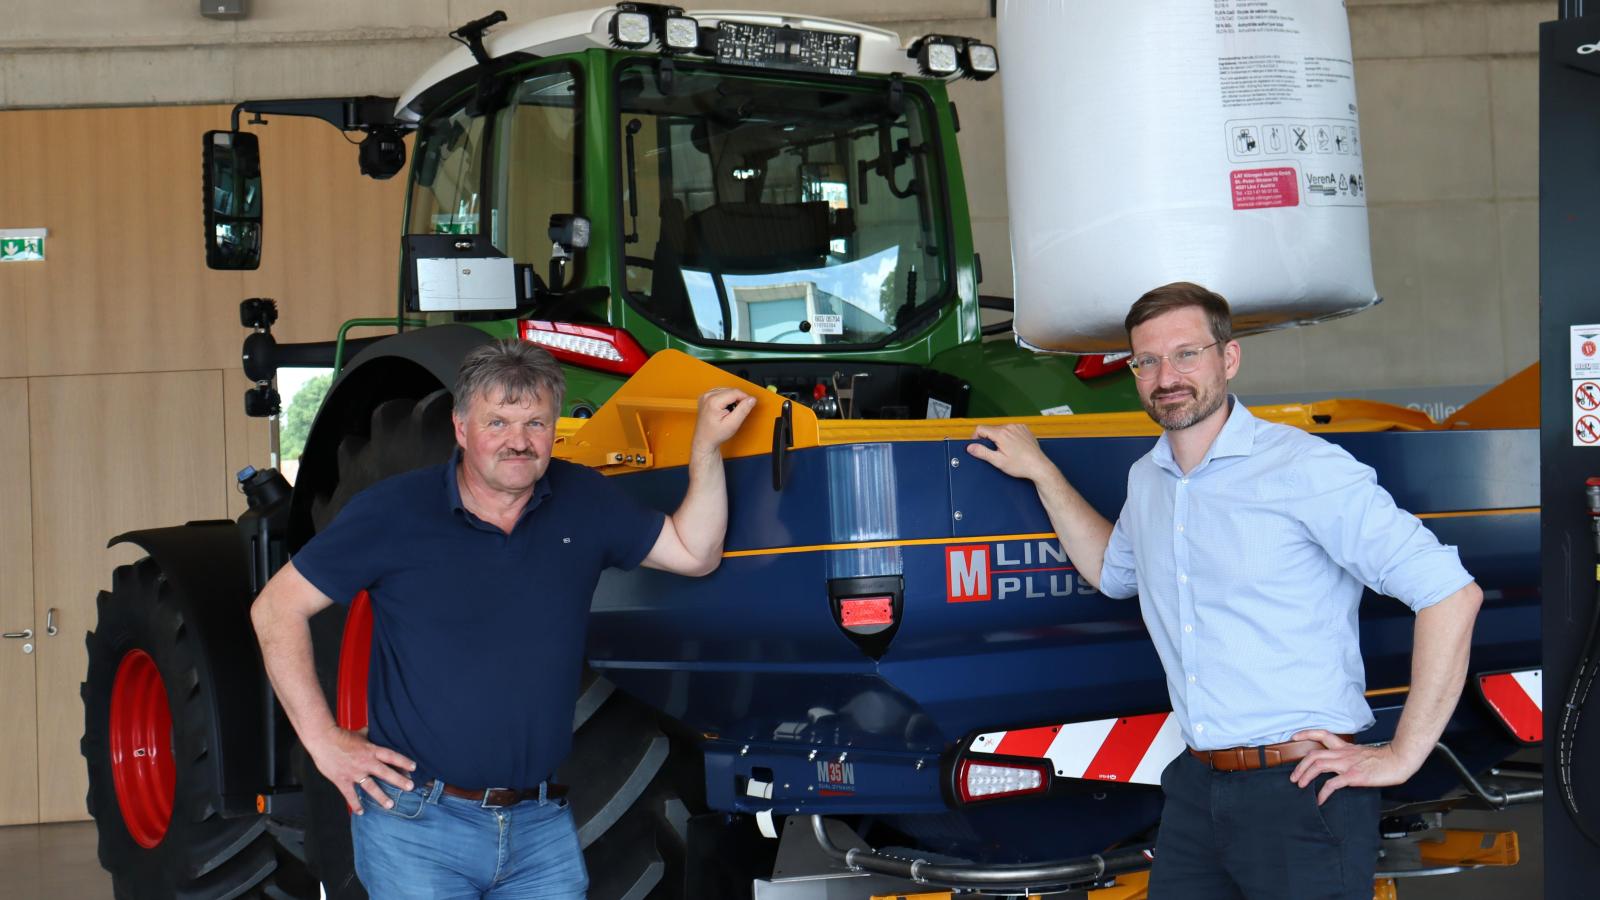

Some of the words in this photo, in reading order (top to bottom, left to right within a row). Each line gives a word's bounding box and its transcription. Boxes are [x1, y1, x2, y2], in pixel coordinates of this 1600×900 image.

[1305, 172, 1337, 185] VerenA
[996, 540, 1068, 566] LIN
[949, 549, 989, 598] M
